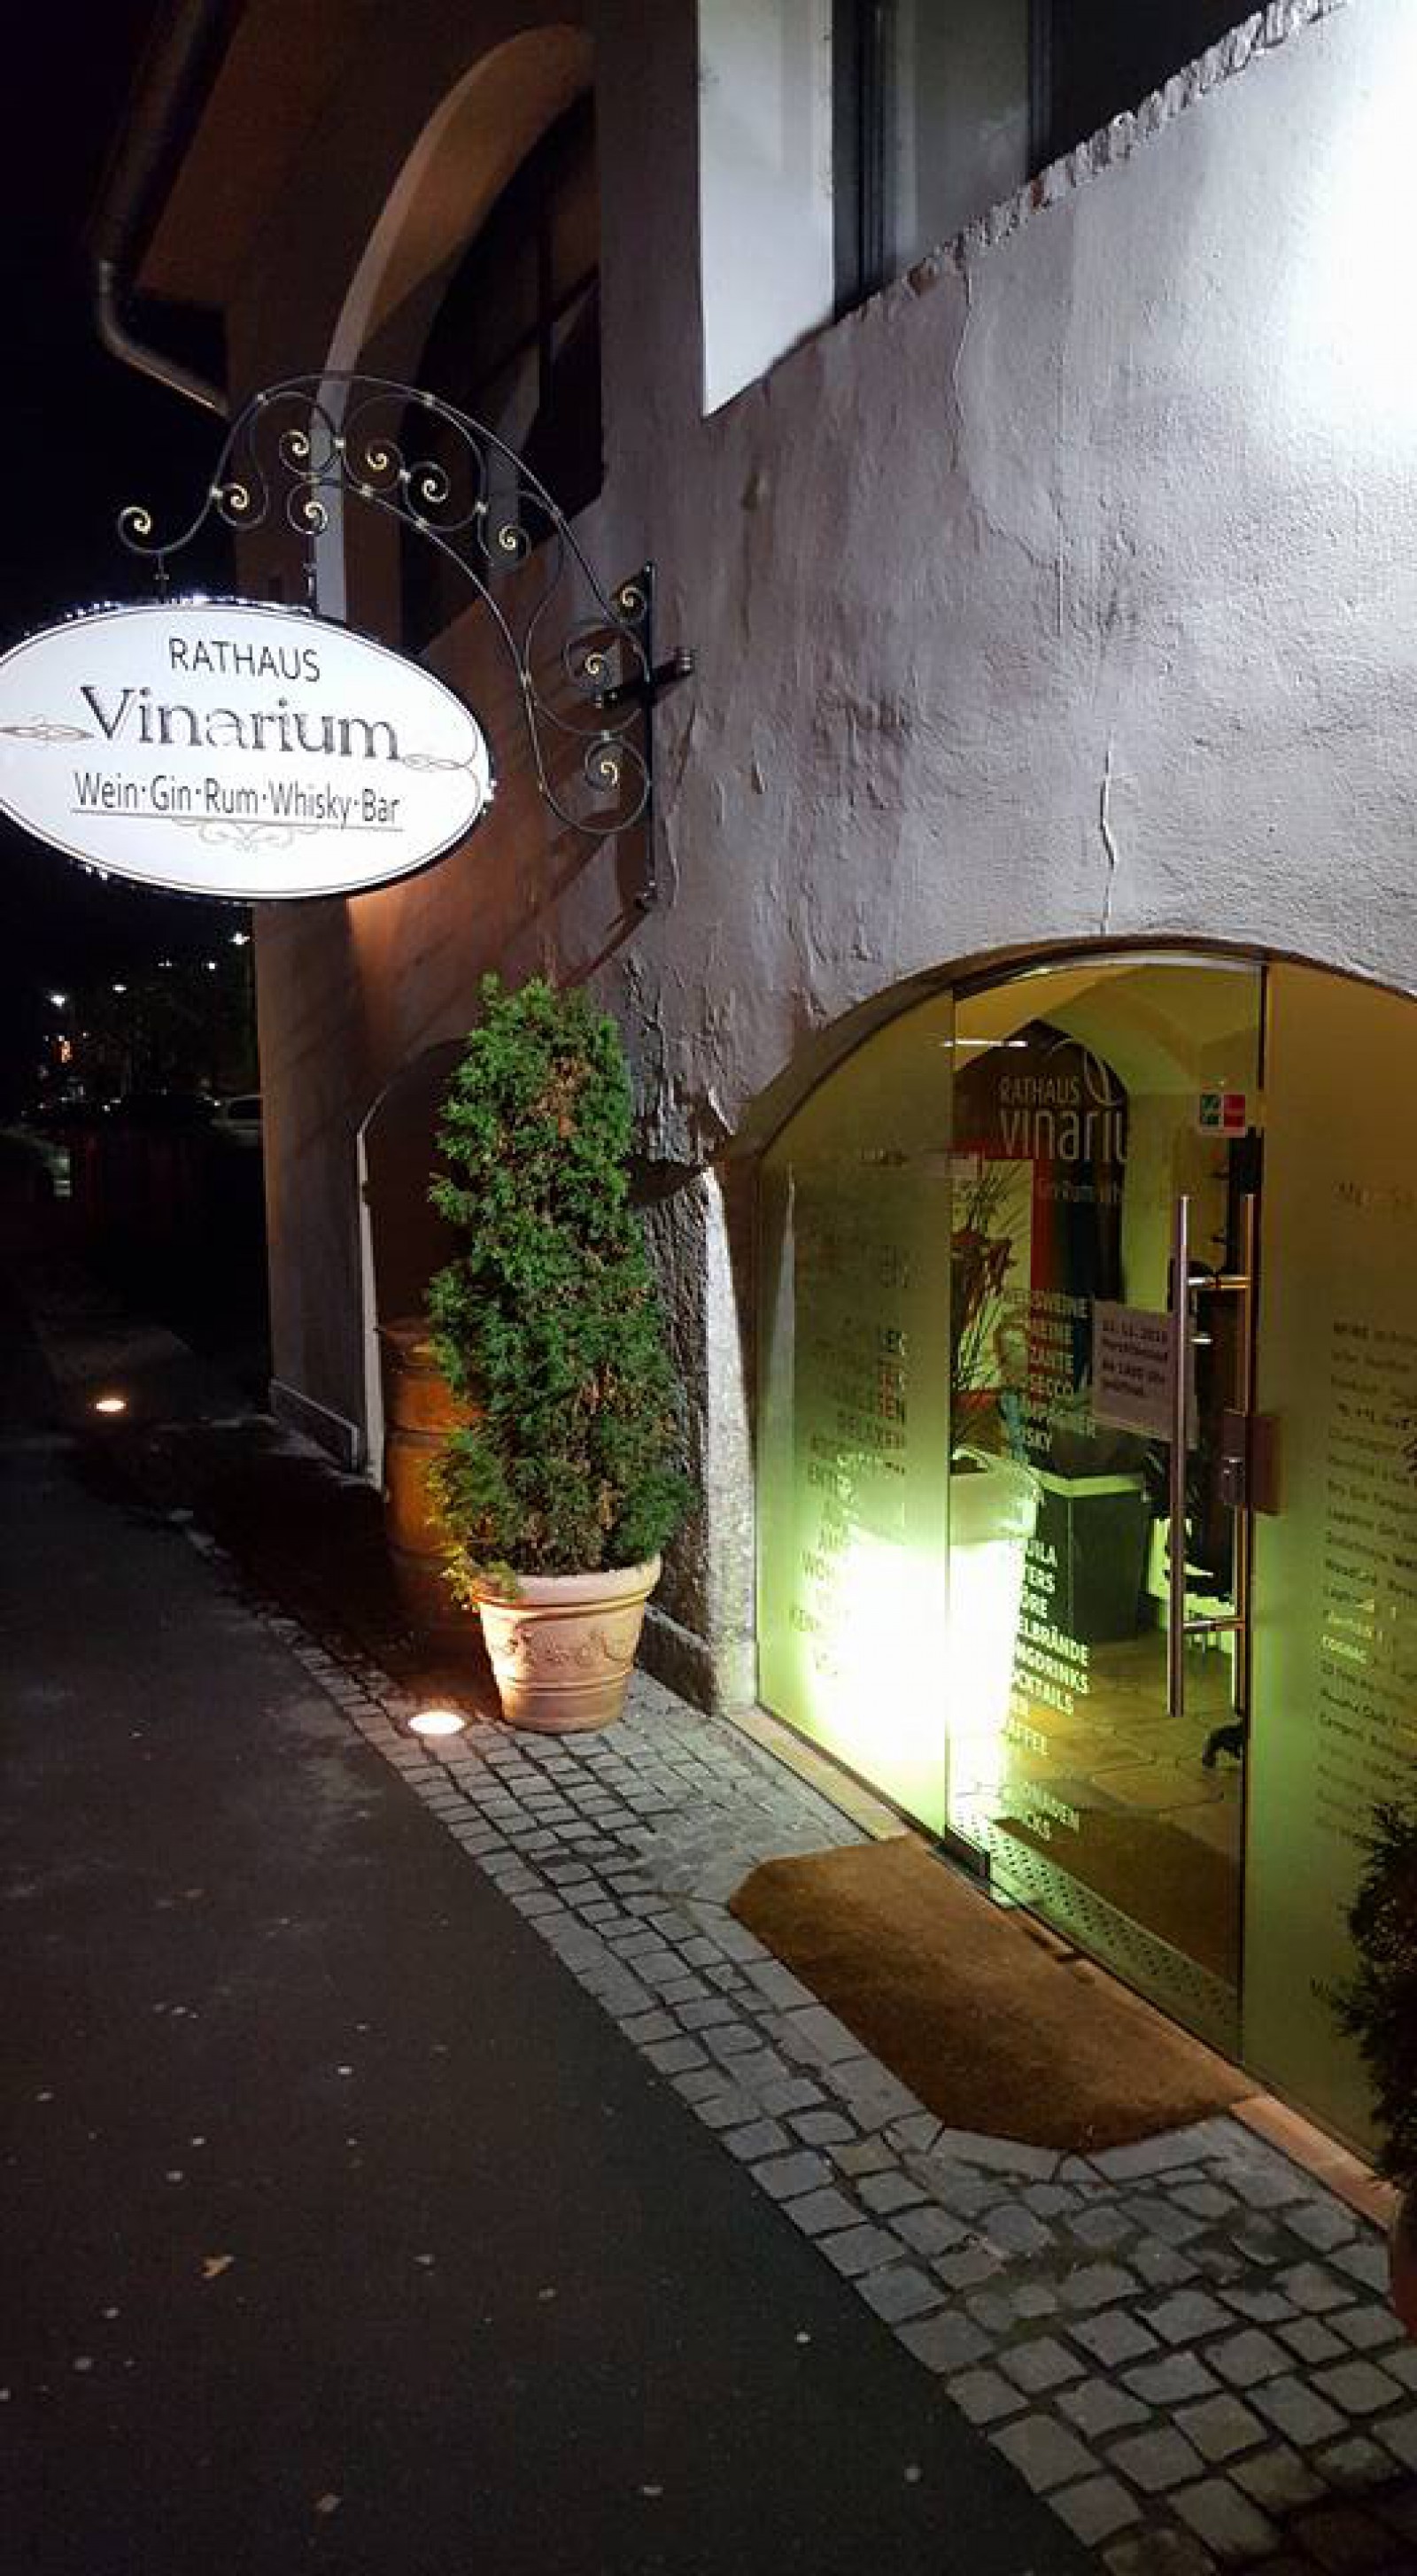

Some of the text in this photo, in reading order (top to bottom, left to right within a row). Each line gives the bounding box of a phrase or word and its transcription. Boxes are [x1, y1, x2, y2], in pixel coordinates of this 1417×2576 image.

[168, 637, 321, 683] RATHAUS
[80, 685, 402, 762] Vinarium
[999, 1074, 1080, 1104] RATHAUS
[999, 1107, 1127, 1163] vinariu
[1018, 1614, 1090, 1667] ELBRÄNDE
[1015, 1644, 1091, 1695] NGDRINKS
